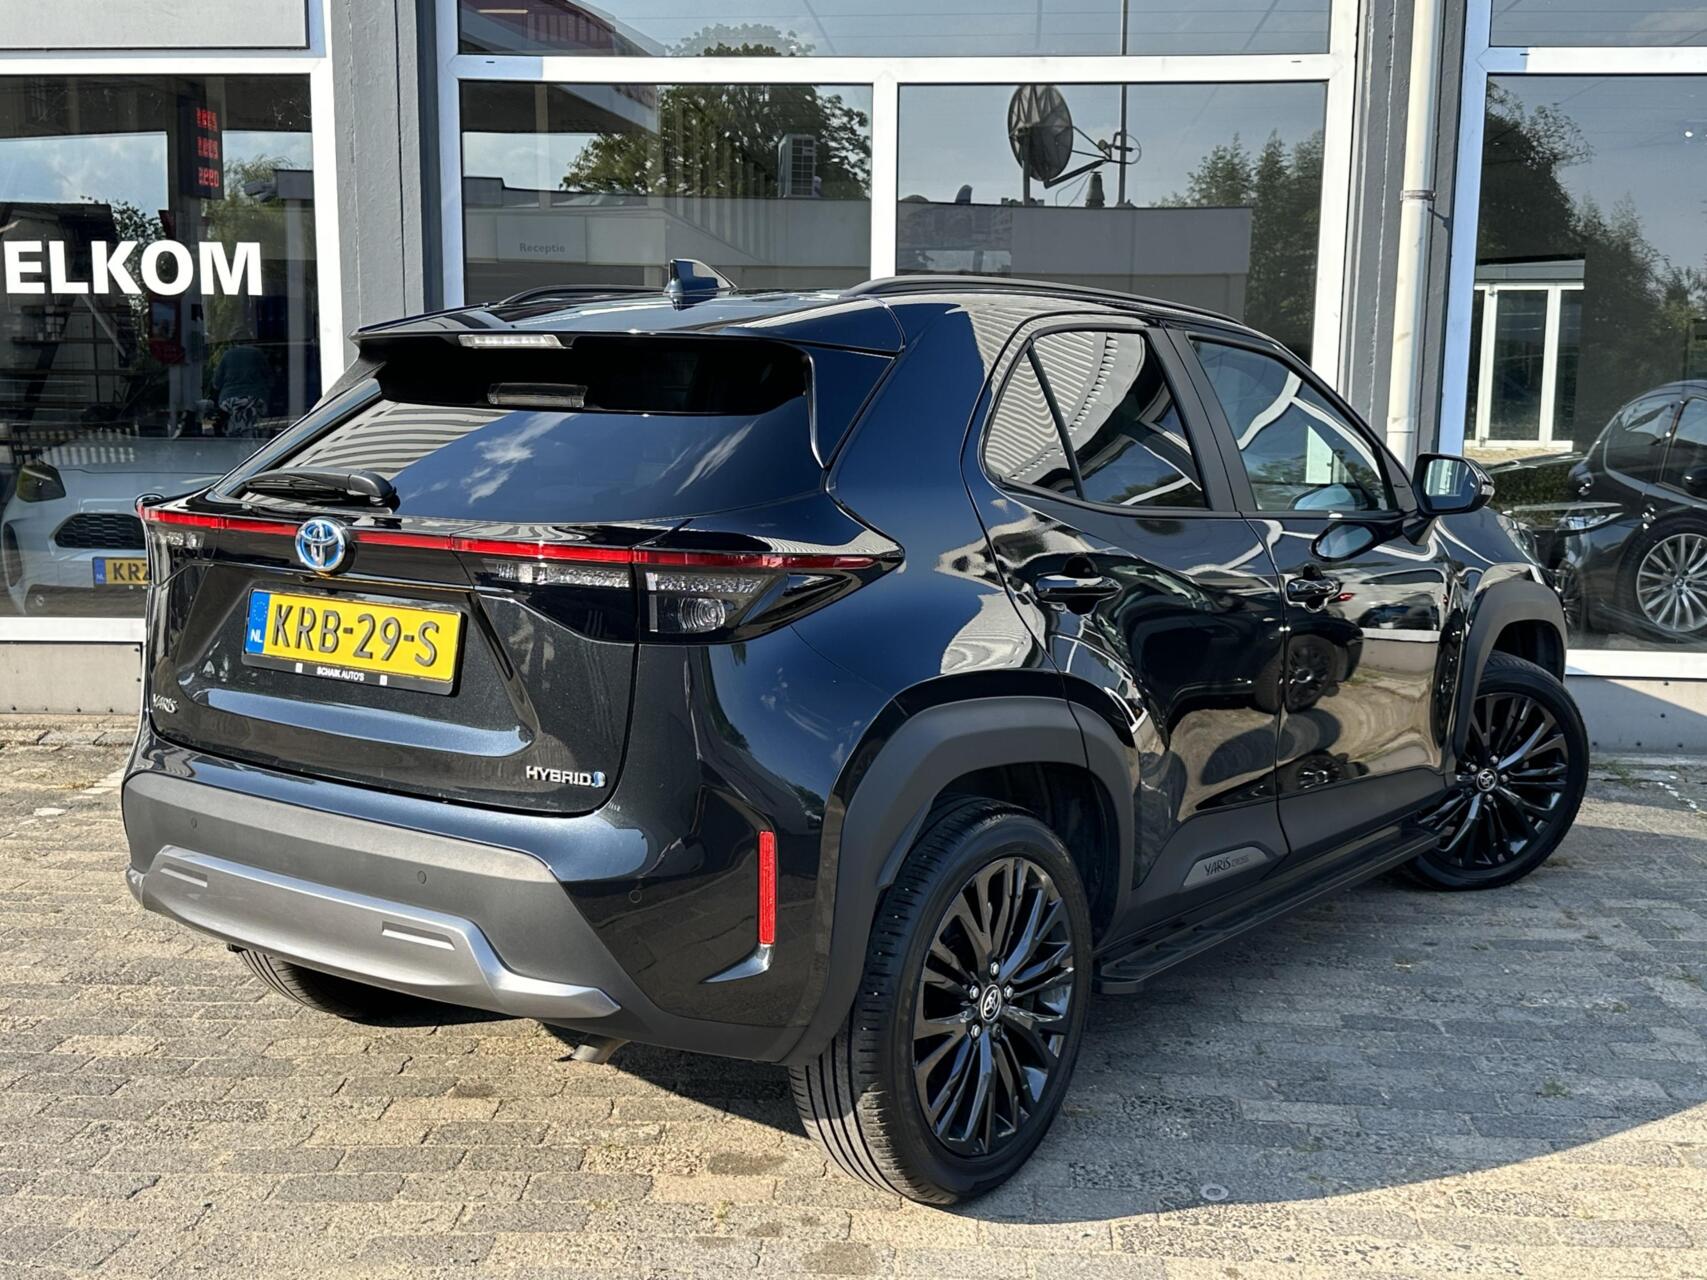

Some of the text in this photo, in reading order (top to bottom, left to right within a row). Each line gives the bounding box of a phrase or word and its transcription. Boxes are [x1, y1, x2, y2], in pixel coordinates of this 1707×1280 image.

[519, 243, 566, 255] Receptie
[4, 240, 262, 296] ELKOM
[250, 629, 263, 643] NL
[272, 604, 440, 667] KRB-29-S
[341, 670, 364, 681] AUTO'S
[526, 765, 591, 786] HYBRID
